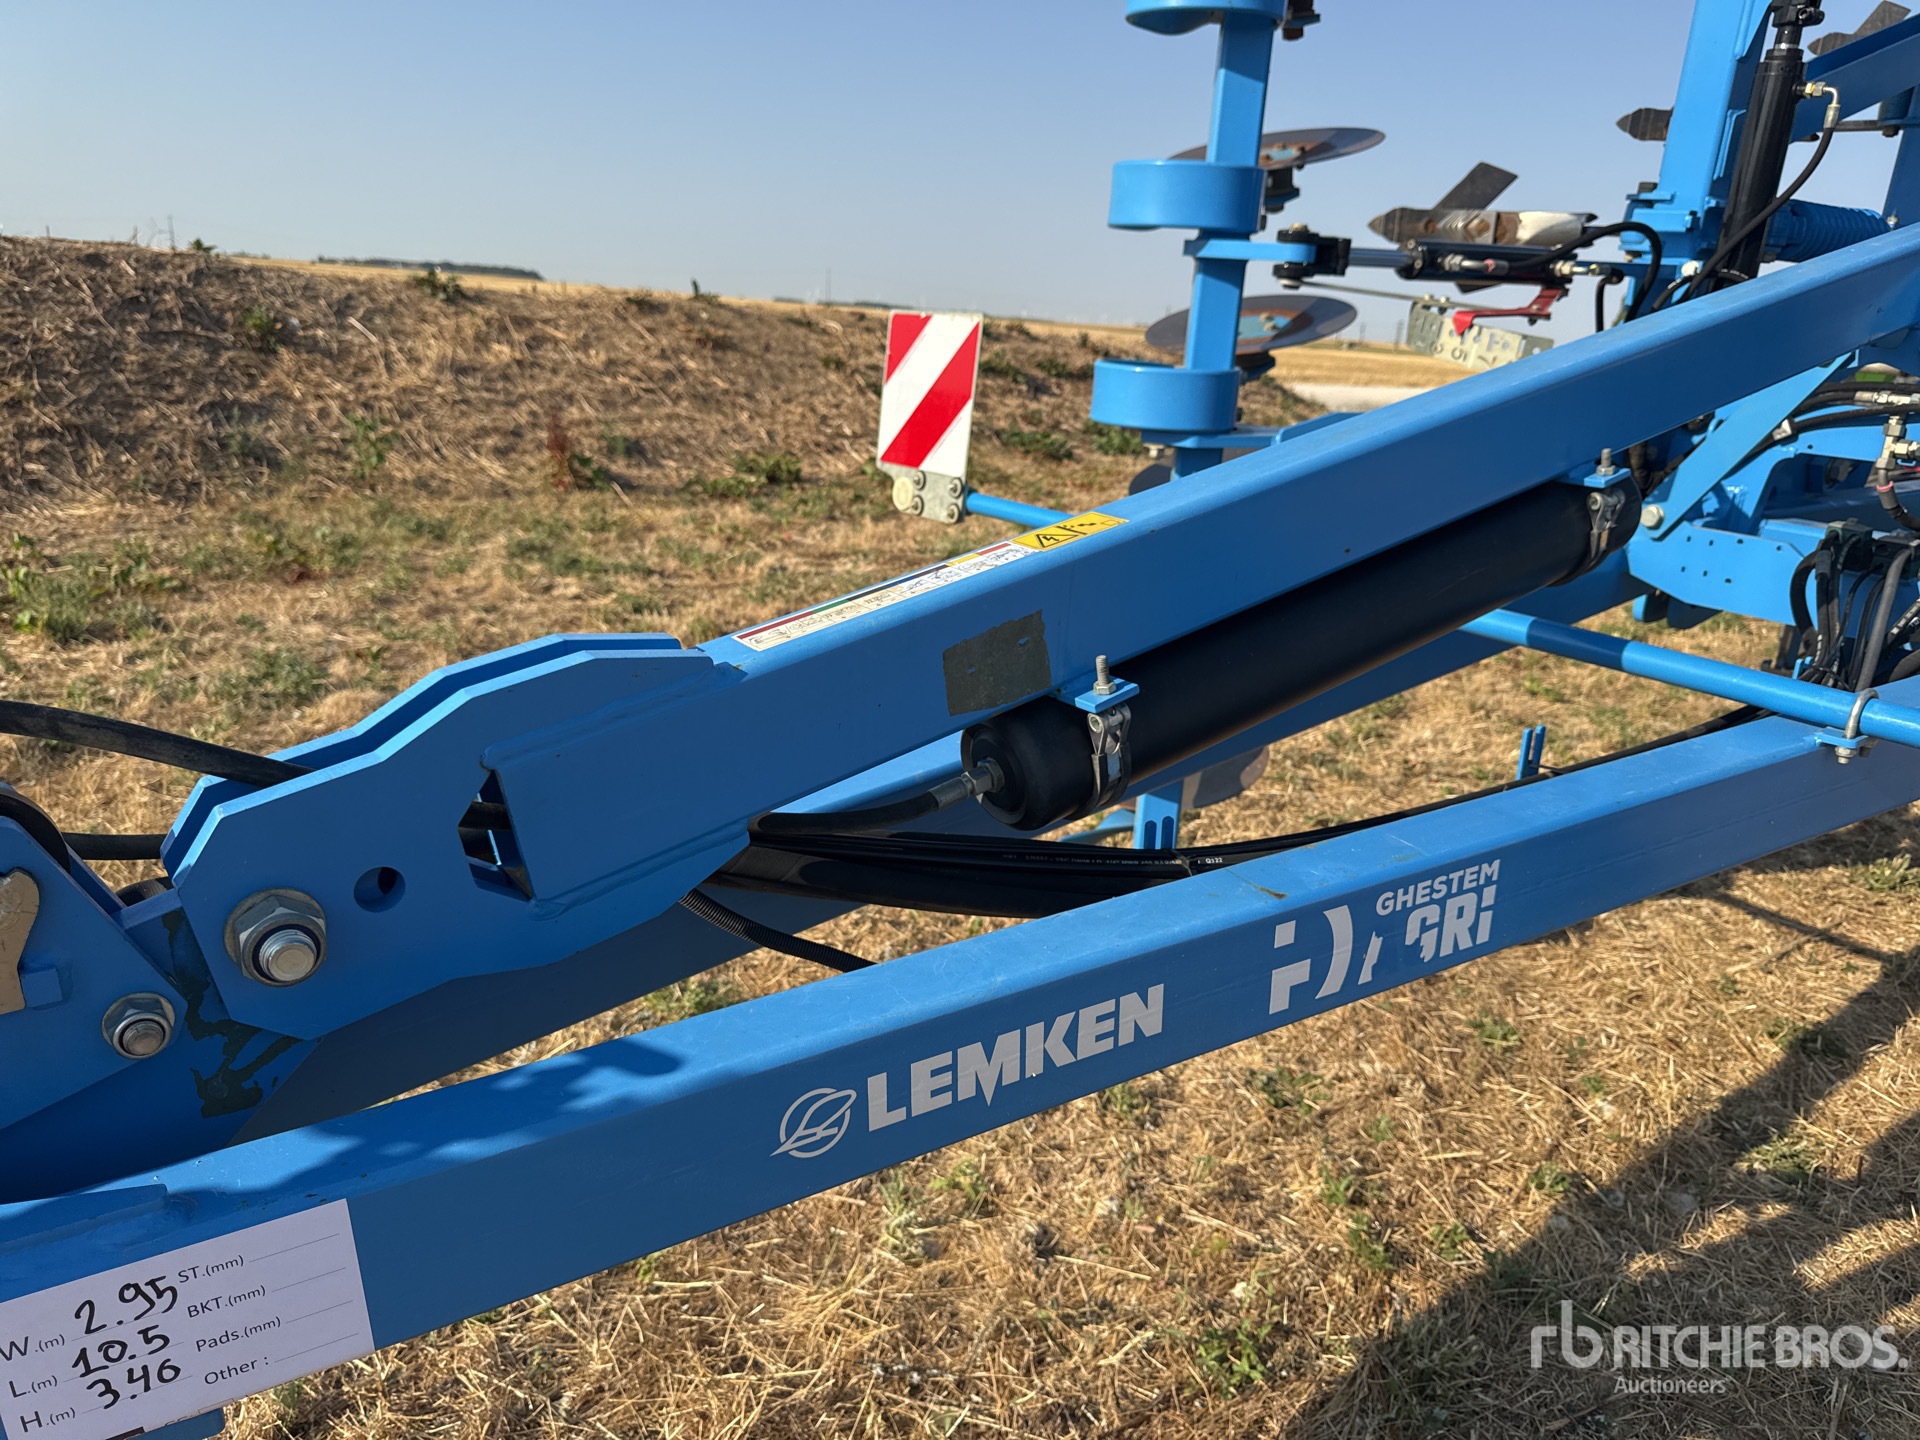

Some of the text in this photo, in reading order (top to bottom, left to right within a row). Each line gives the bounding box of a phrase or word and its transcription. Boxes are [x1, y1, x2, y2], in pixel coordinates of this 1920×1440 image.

[1376, 859, 1500, 916] GHESTEM
[867, 983, 1164, 1132] LEMKEN
[178, 1255, 244, 1283] ST.(mm)
[74, 1275, 178, 1334] 2.95
[187, 1285, 266, 1318] BKT.(mm)
[71, 1324, 170, 1378] 10.5
[196, 1316, 281, 1352] Pads.(mm)
[9, 1374, 58, 1398] L.(m)
[86, 1358, 181, 1409] 3.46
[204, 1359, 258, 1385] Other
[20, 1407, 76, 1433] H.(m)
